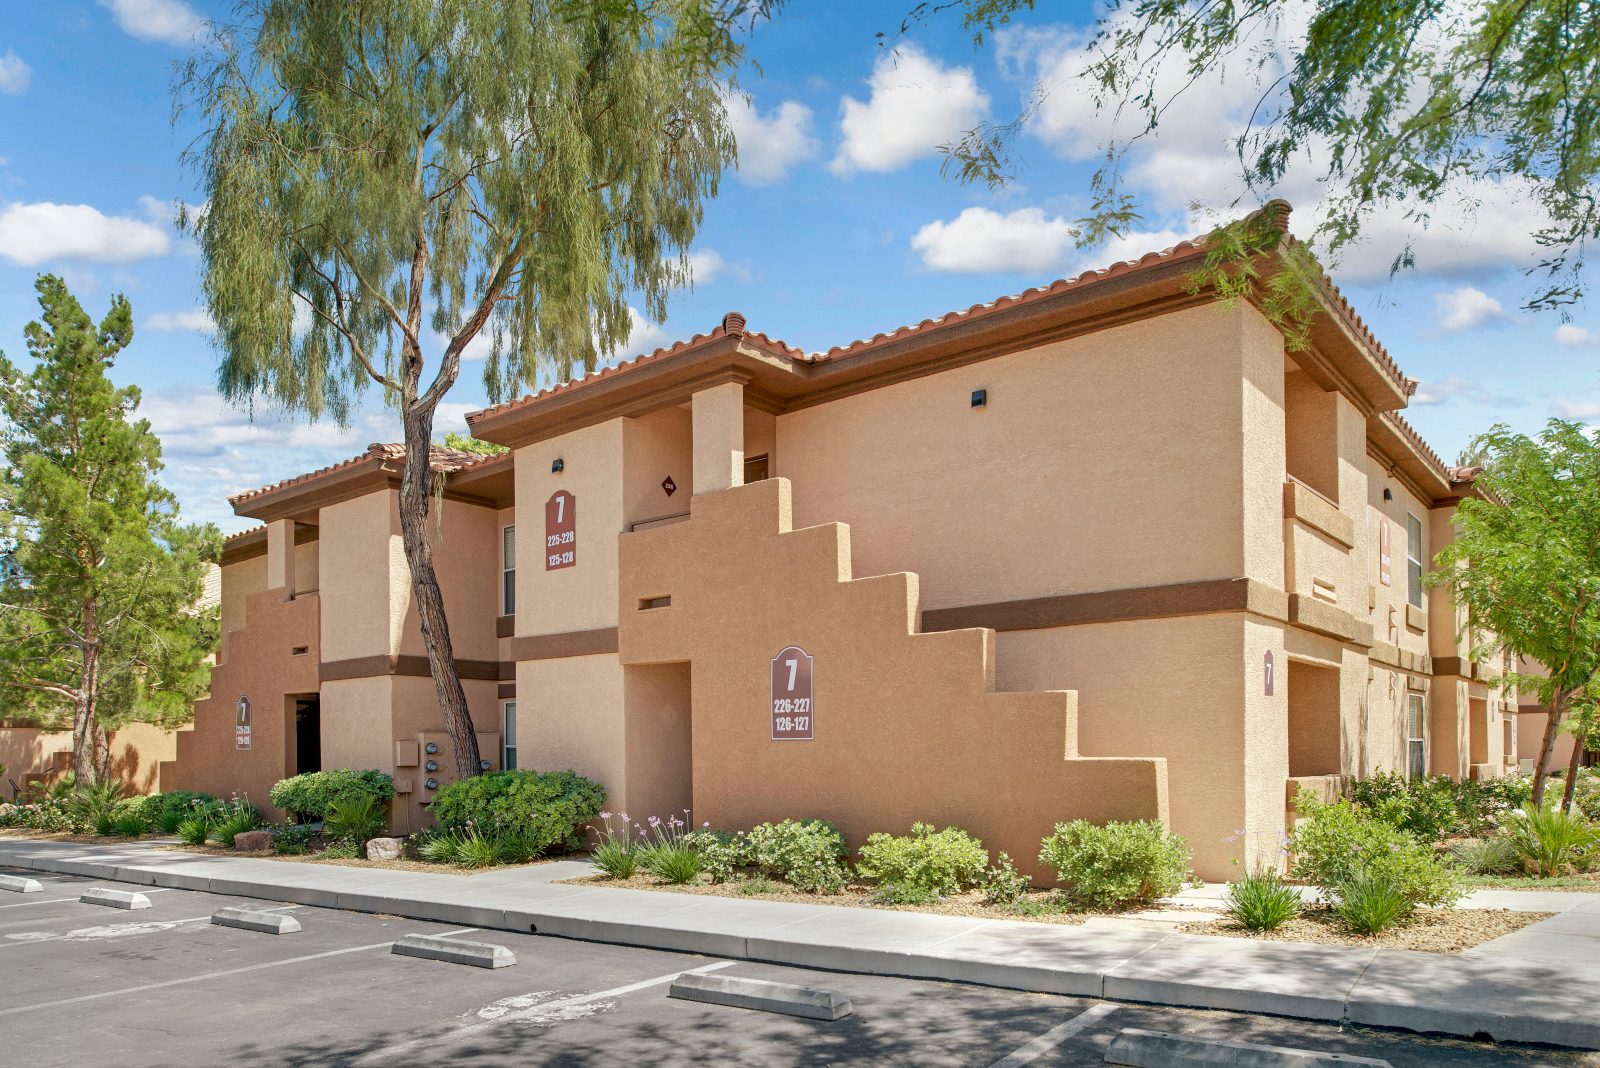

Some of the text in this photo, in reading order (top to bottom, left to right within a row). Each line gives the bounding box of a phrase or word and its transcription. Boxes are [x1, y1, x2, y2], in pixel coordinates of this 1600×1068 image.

[556, 496, 565, 523] 7
[547, 531, 574, 547] 225-228
[549, 551, 574, 566] 125-128
[785, 659, 798, 691] 7
[1267, 664, 1271, 684] 7
[242, 703, 247, 721] 7
[774, 698, 810, 713] 226-227
[775, 716, 809, 731] 126-127
